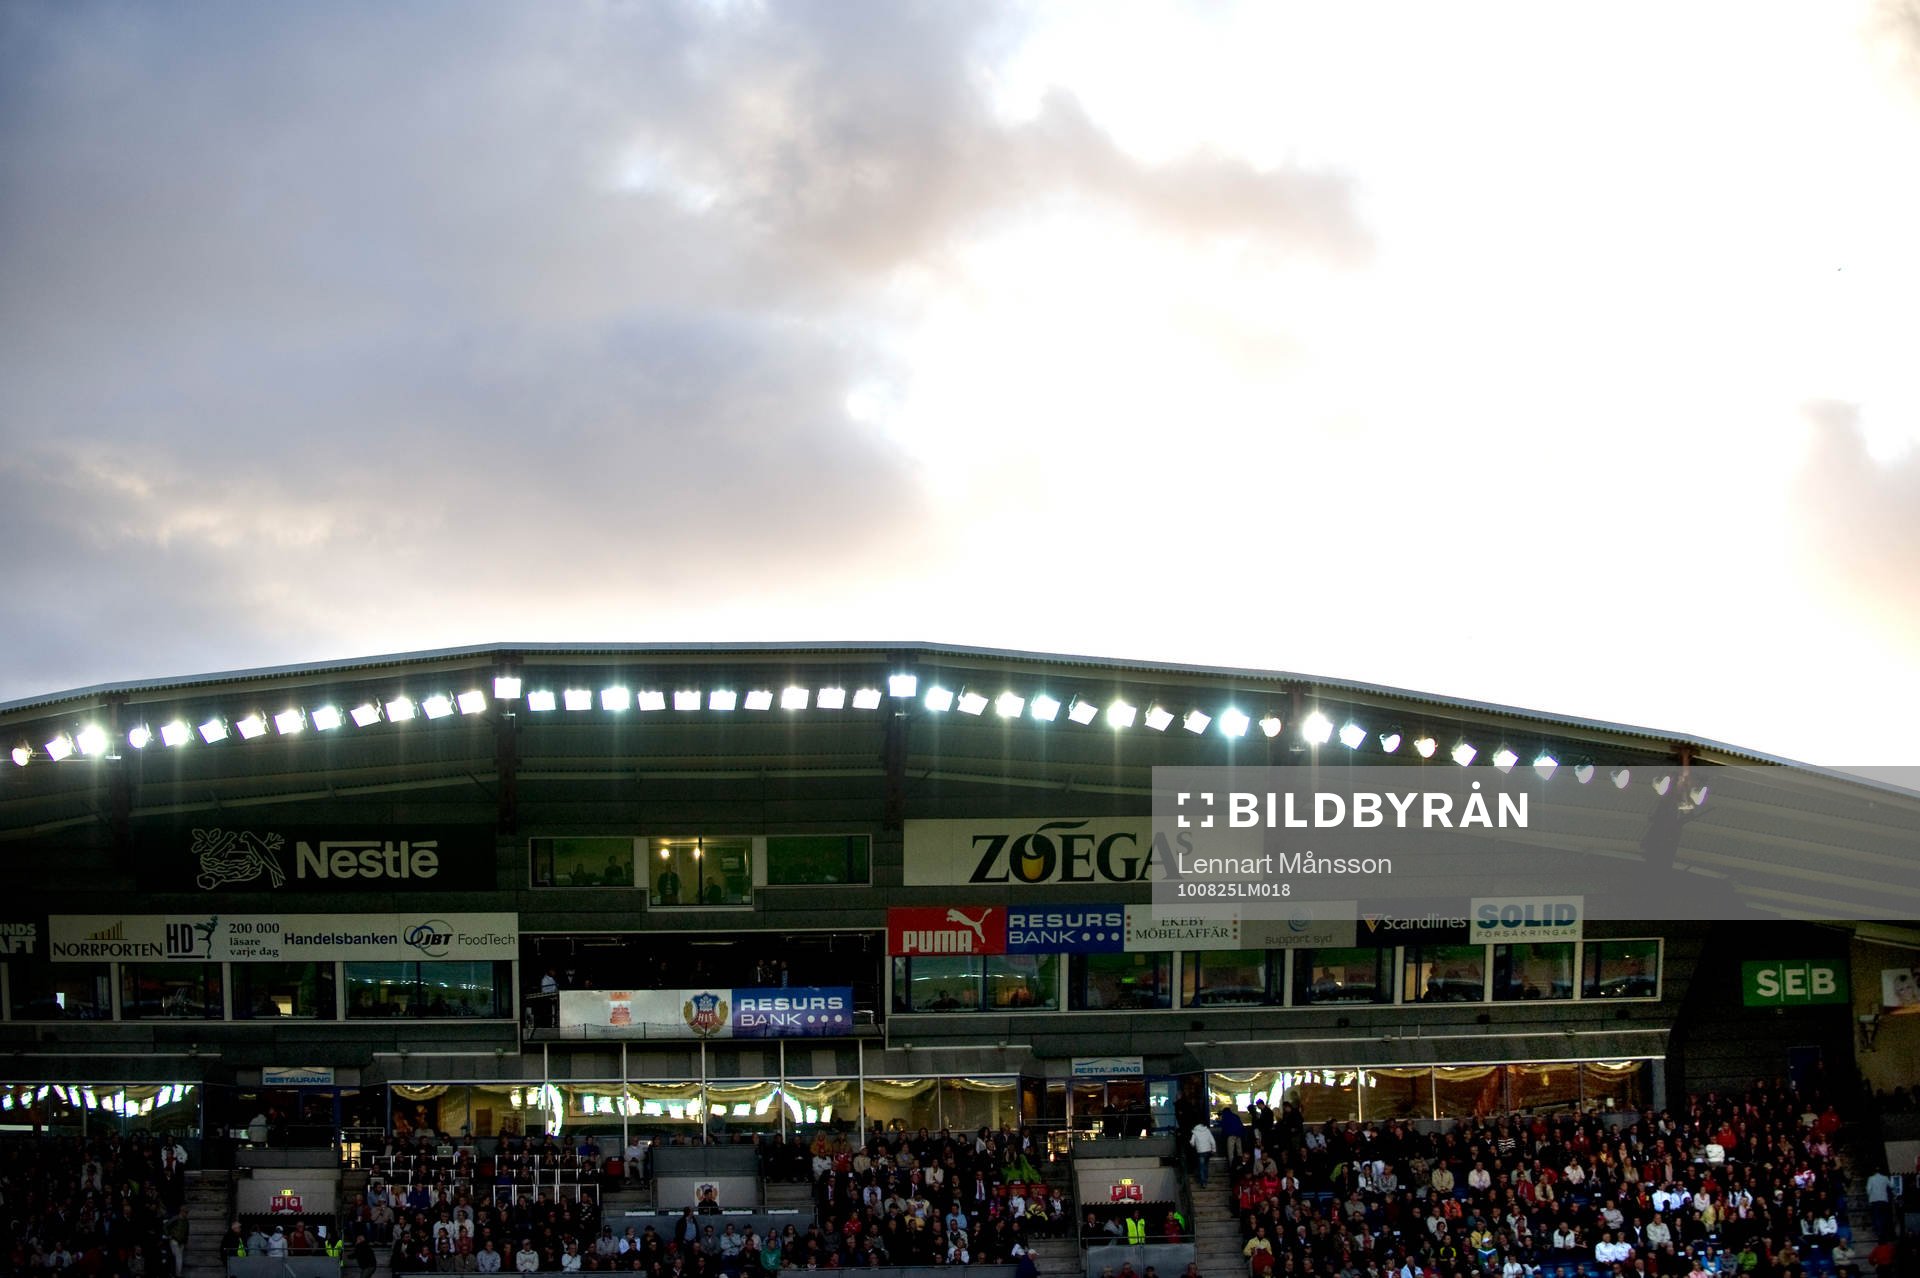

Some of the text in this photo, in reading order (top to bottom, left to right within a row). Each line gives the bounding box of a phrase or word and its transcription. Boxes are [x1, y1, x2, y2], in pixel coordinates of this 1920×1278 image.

[295, 840, 440, 879] Nestlé
[1008, 912, 1123, 929] RESURS
[1161, 915, 1207, 927] EKEBY
[1383, 912, 1467, 931] Scandlines
[1477, 903, 1578, 930] SOLID
[228, 922, 280, 934] 200 000
[1135, 926, 1230, 940] MÖBELAFFÄR
[166, 923, 194, 954] HD
[229, 937, 261, 946] läsare
[284, 932, 398, 946] Handelsbanken
[457, 932, 516, 946] FoodTech
[902, 929, 973, 953] PUMA
[1008, 930, 1076, 945] BANK
[1265, 933, 1333, 945] support syd
[53, 941, 164, 957] NORRPORTEN
[229, 947, 280, 958] varje dag
[740, 996, 844, 1012] RESURS
[740, 1012, 802, 1027] BANK
